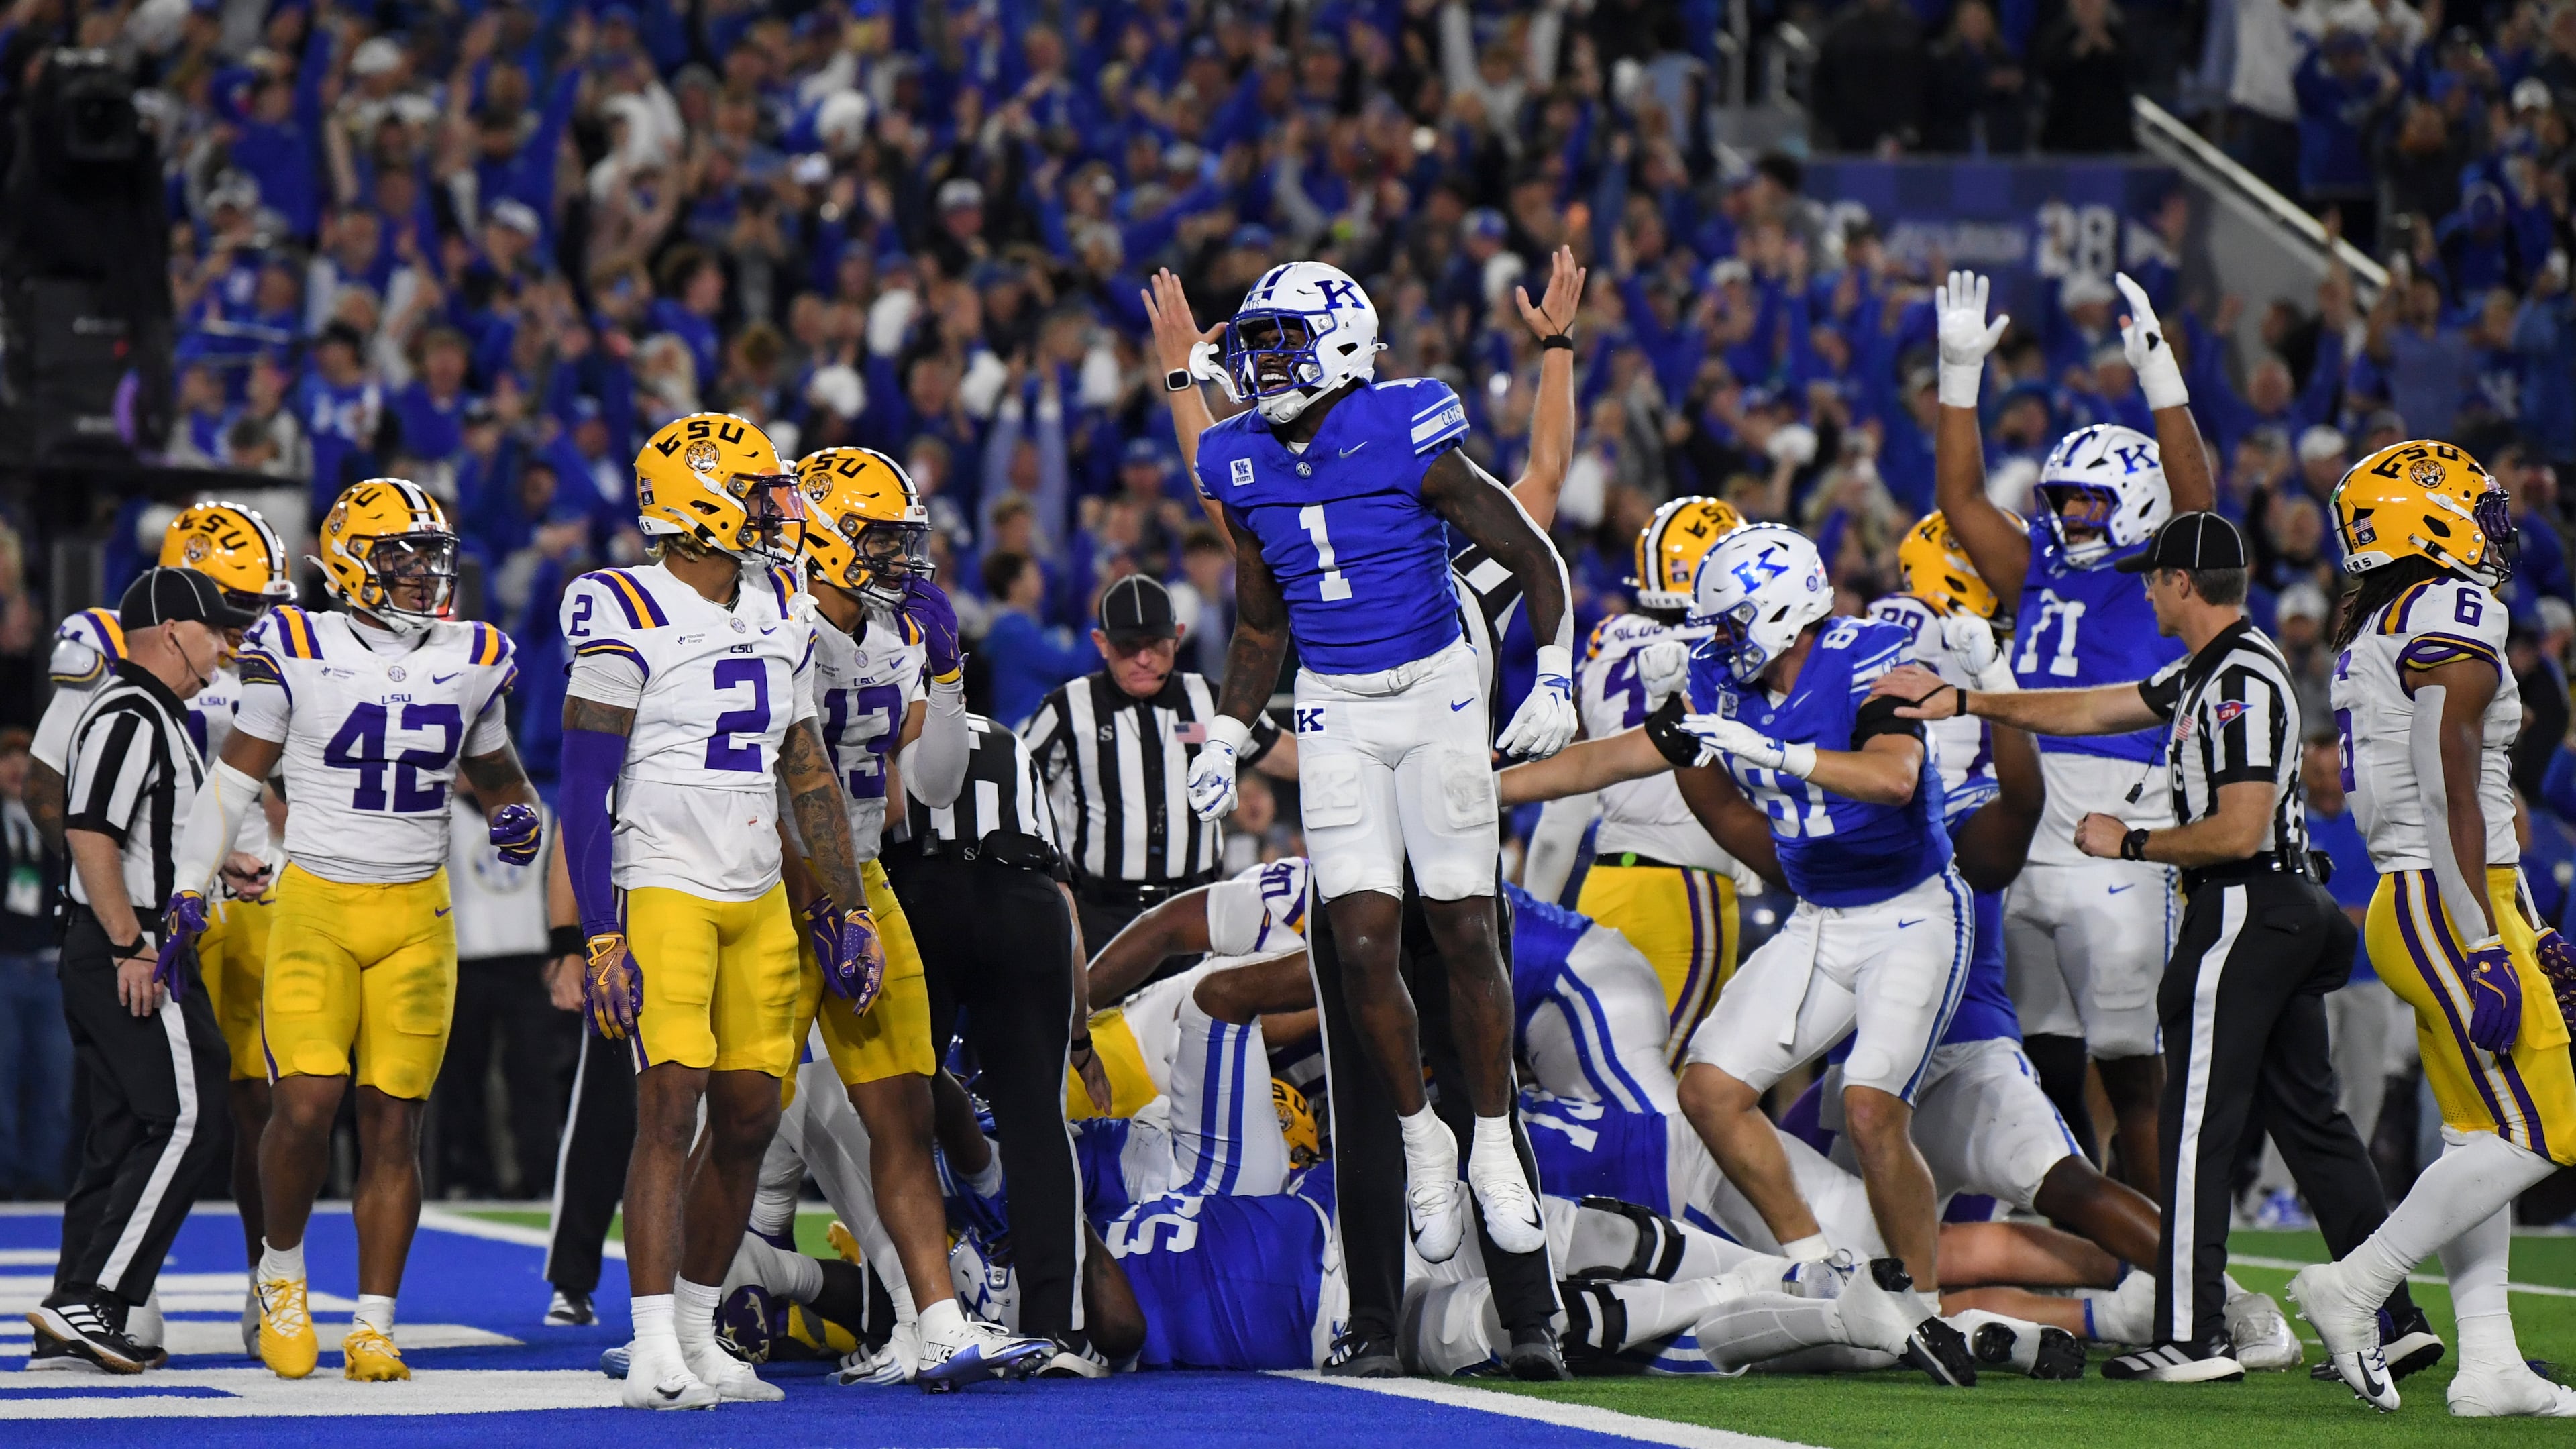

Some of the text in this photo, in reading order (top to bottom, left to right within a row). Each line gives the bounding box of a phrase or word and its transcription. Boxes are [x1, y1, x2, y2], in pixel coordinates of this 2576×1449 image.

[1314, 280, 1366, 309] K
[1441, 406, 1462, 426] CATS
[655, 421, 745, 458] LSU
[2114, 444, 2159, 475] K
[2371, 445, 2459, 480] LSU
[179, 514, 248, 551] LSU
[1299, 501, 1353, 602] 1
[1731, 546, 1790, 596] K
[568, 594, 593, 637] 2
[2455, 587, 2483, 627] 6
[199, 696, 227, 706] LSU
[382, 694, 411, 705] LSU
[704, 658, 771, 773] 2
[1099, 724, 1114, 741] S
[1297, 708, 1324, 733] K
[323, 702, 464, 812] 42
[823, 684, 902, 800] 13
[2172, 763, 2184, 792] C
[1732, 752, 1835, 839] 81
[964, 847, 975, 861] S
[921, 1342, 953, 1364] NIKE
